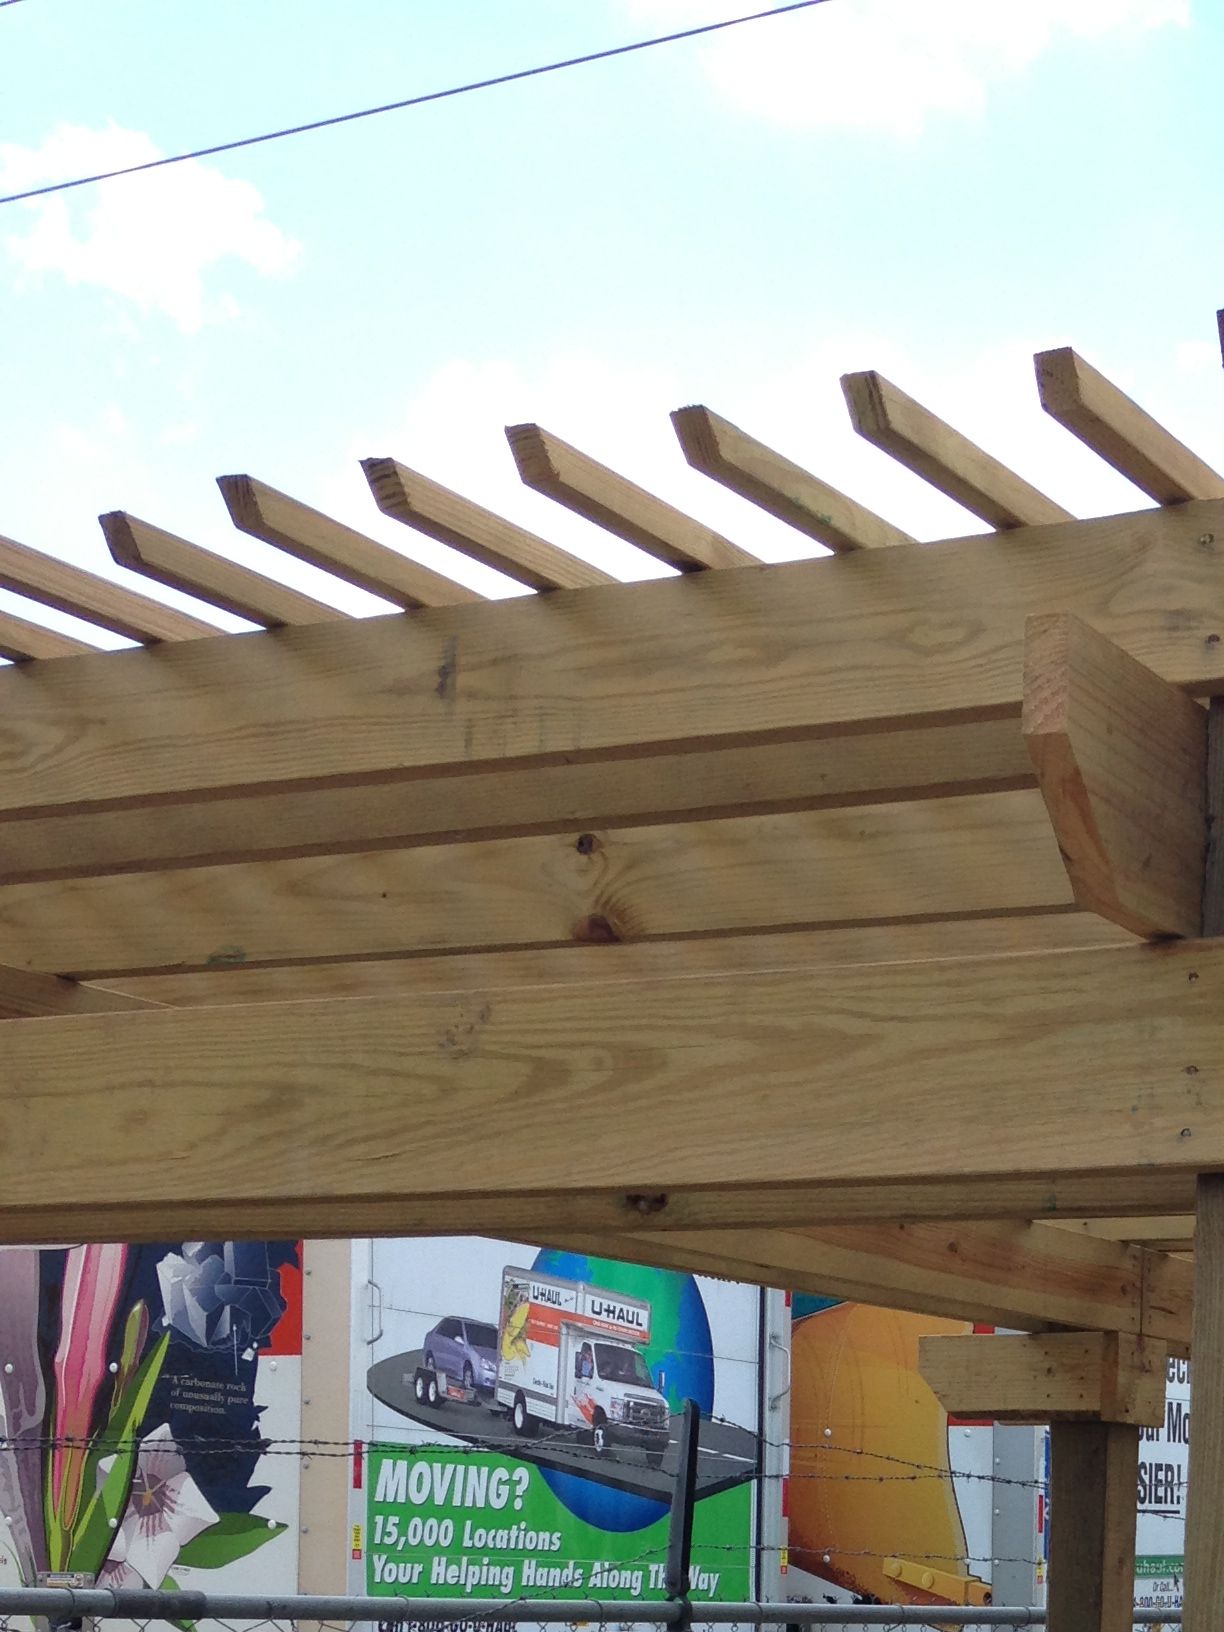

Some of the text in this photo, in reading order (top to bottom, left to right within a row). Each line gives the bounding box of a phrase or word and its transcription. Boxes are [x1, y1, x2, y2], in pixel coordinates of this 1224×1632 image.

[170, 1388, 249, 1405] of unusually pure
[180, 1378, 225, 1389] carbonate
[226, 1382, 246, 1392] rock
[374, 1458, 530, 1511] MOVING?
[1137, 1461, 1181, 1505] SIER!
[373, 1515, 454, 1551] 15,000
[462, 1519, 562, 1551] Locations
[372, 1554, 424, 1584] Your
[430, 1556, 515, 1594] Helping
[521, 1559, 584, 1588] Hands
[588, 1561, 643, 1596] Along
[649, 1563, 667, 1589] Th
